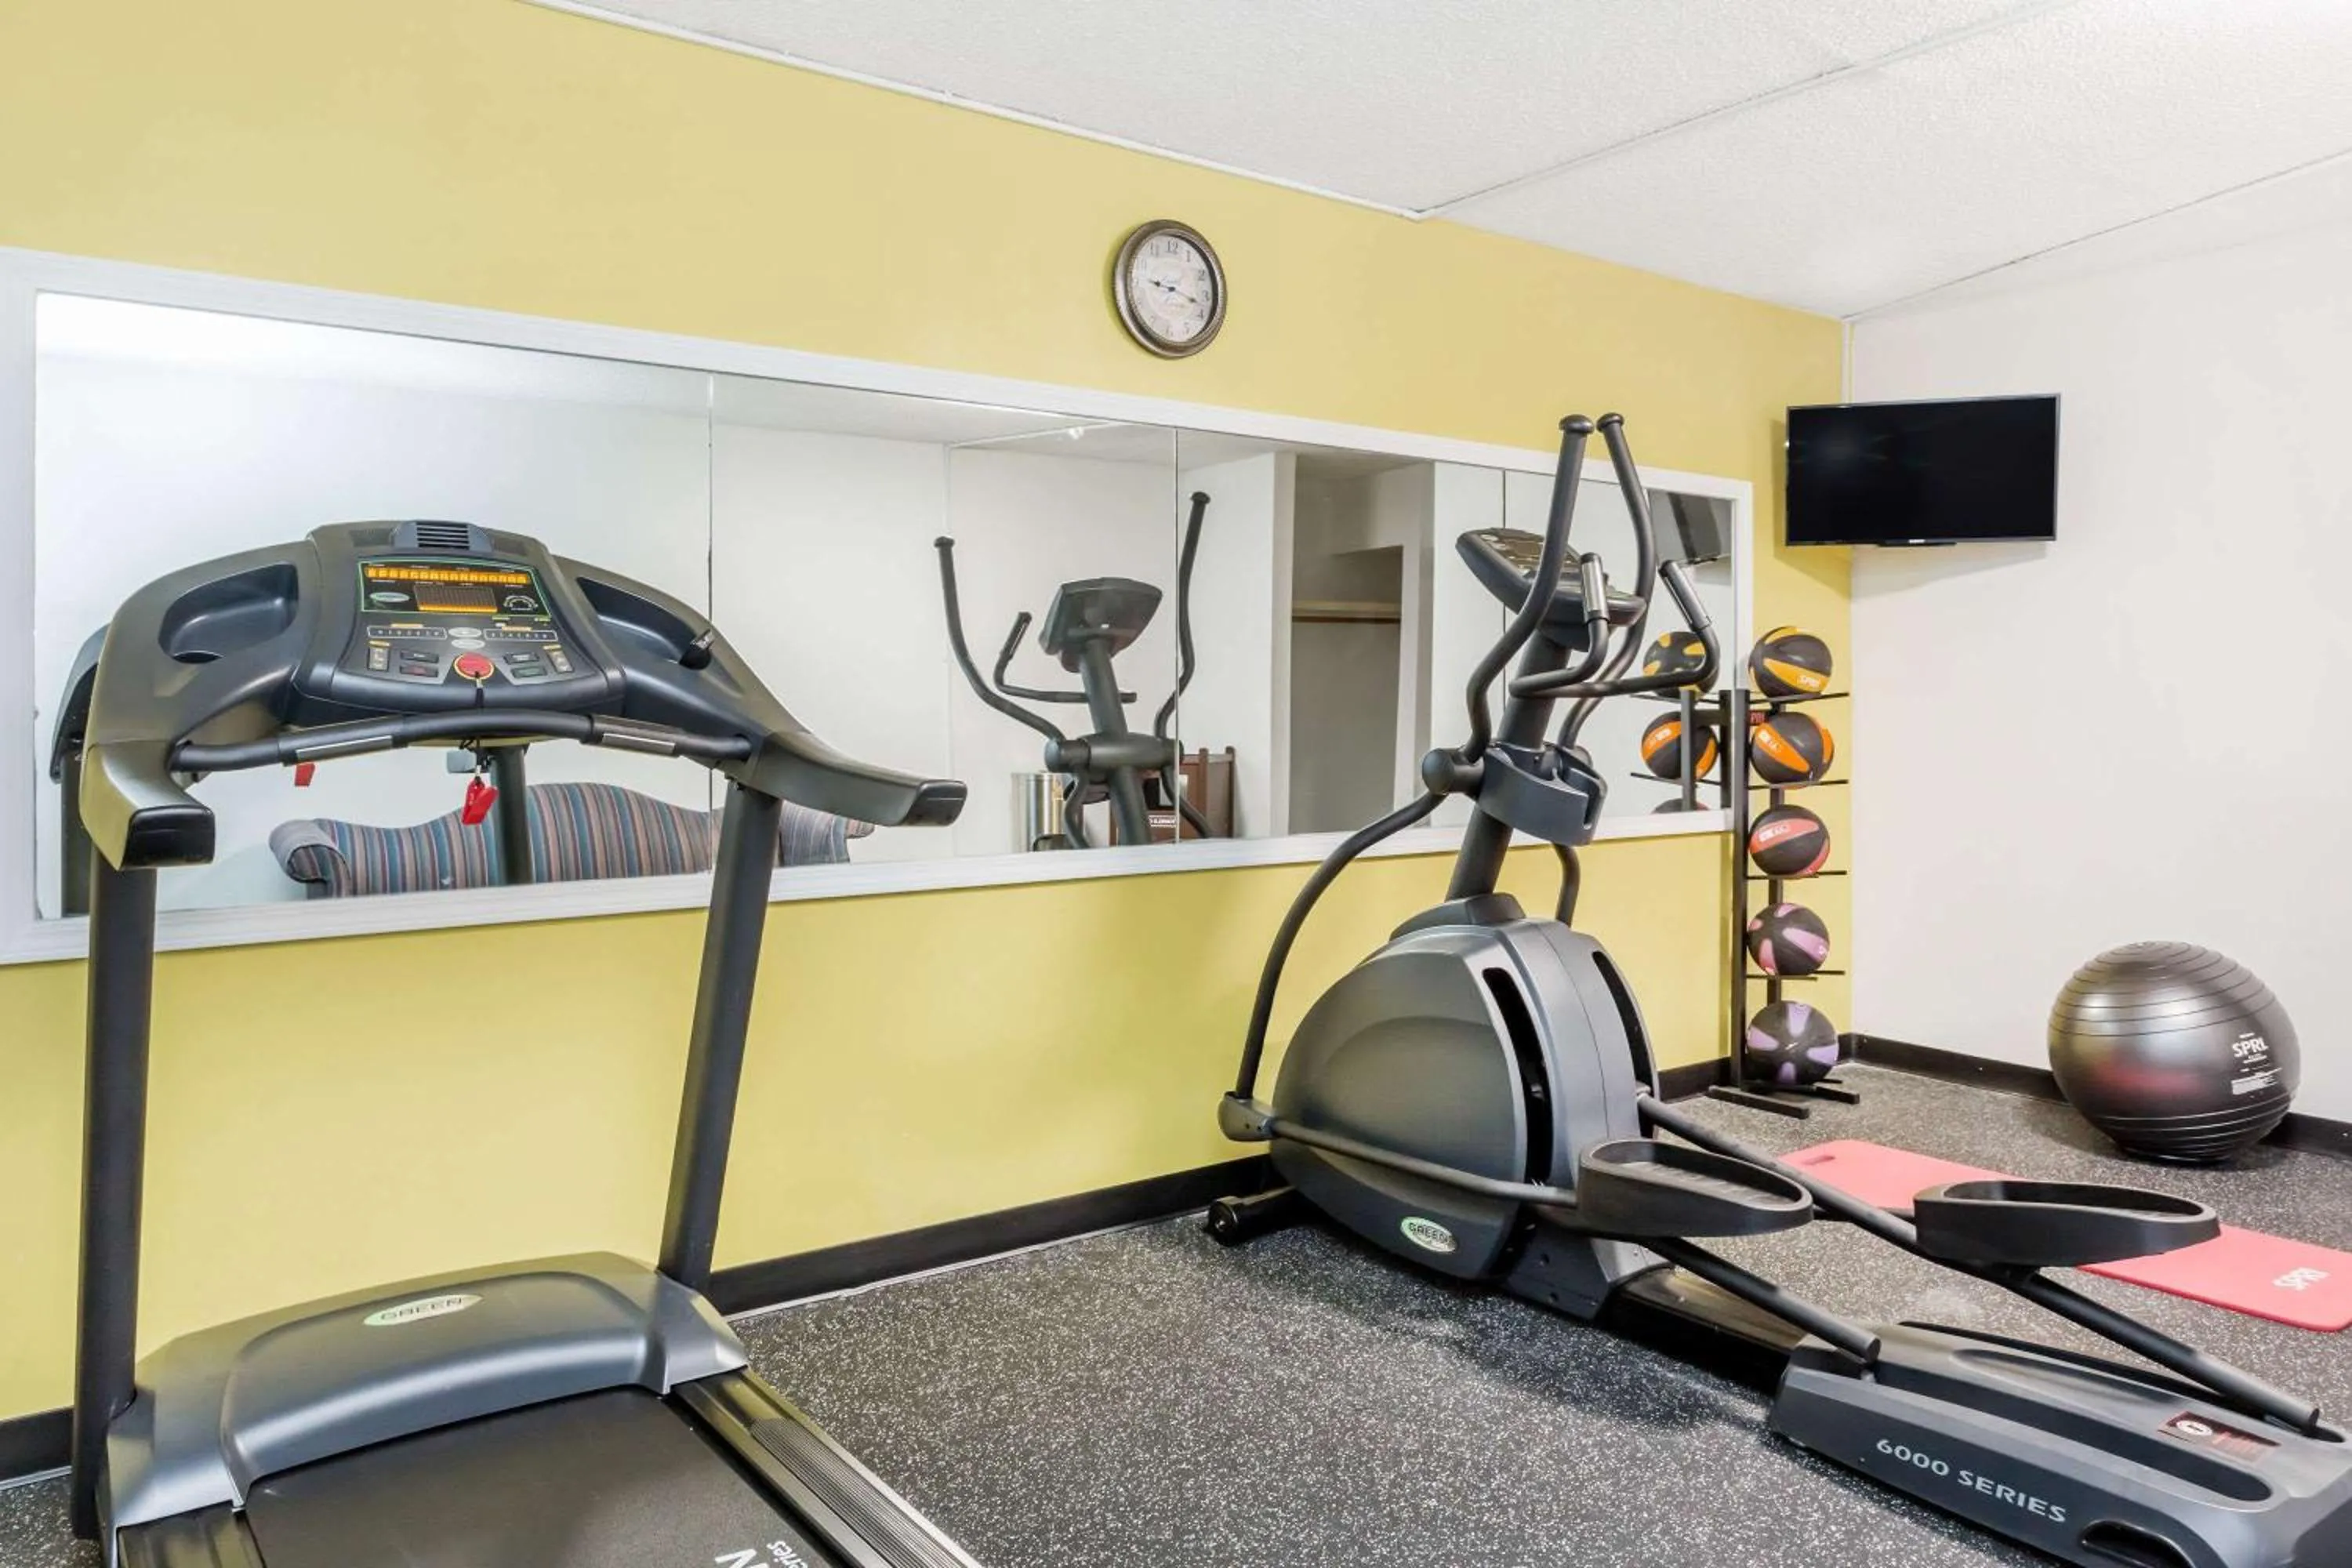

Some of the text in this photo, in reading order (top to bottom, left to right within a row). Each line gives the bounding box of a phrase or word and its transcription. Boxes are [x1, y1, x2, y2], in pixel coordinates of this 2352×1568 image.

[1165, 239, 1178, 255] 12
[1409, 1222, 1450, 1244] GREEN
[380, 1298, 463, 1320] GREEN
[1876, 1439, 2067, 1523] 6000 SERIES
